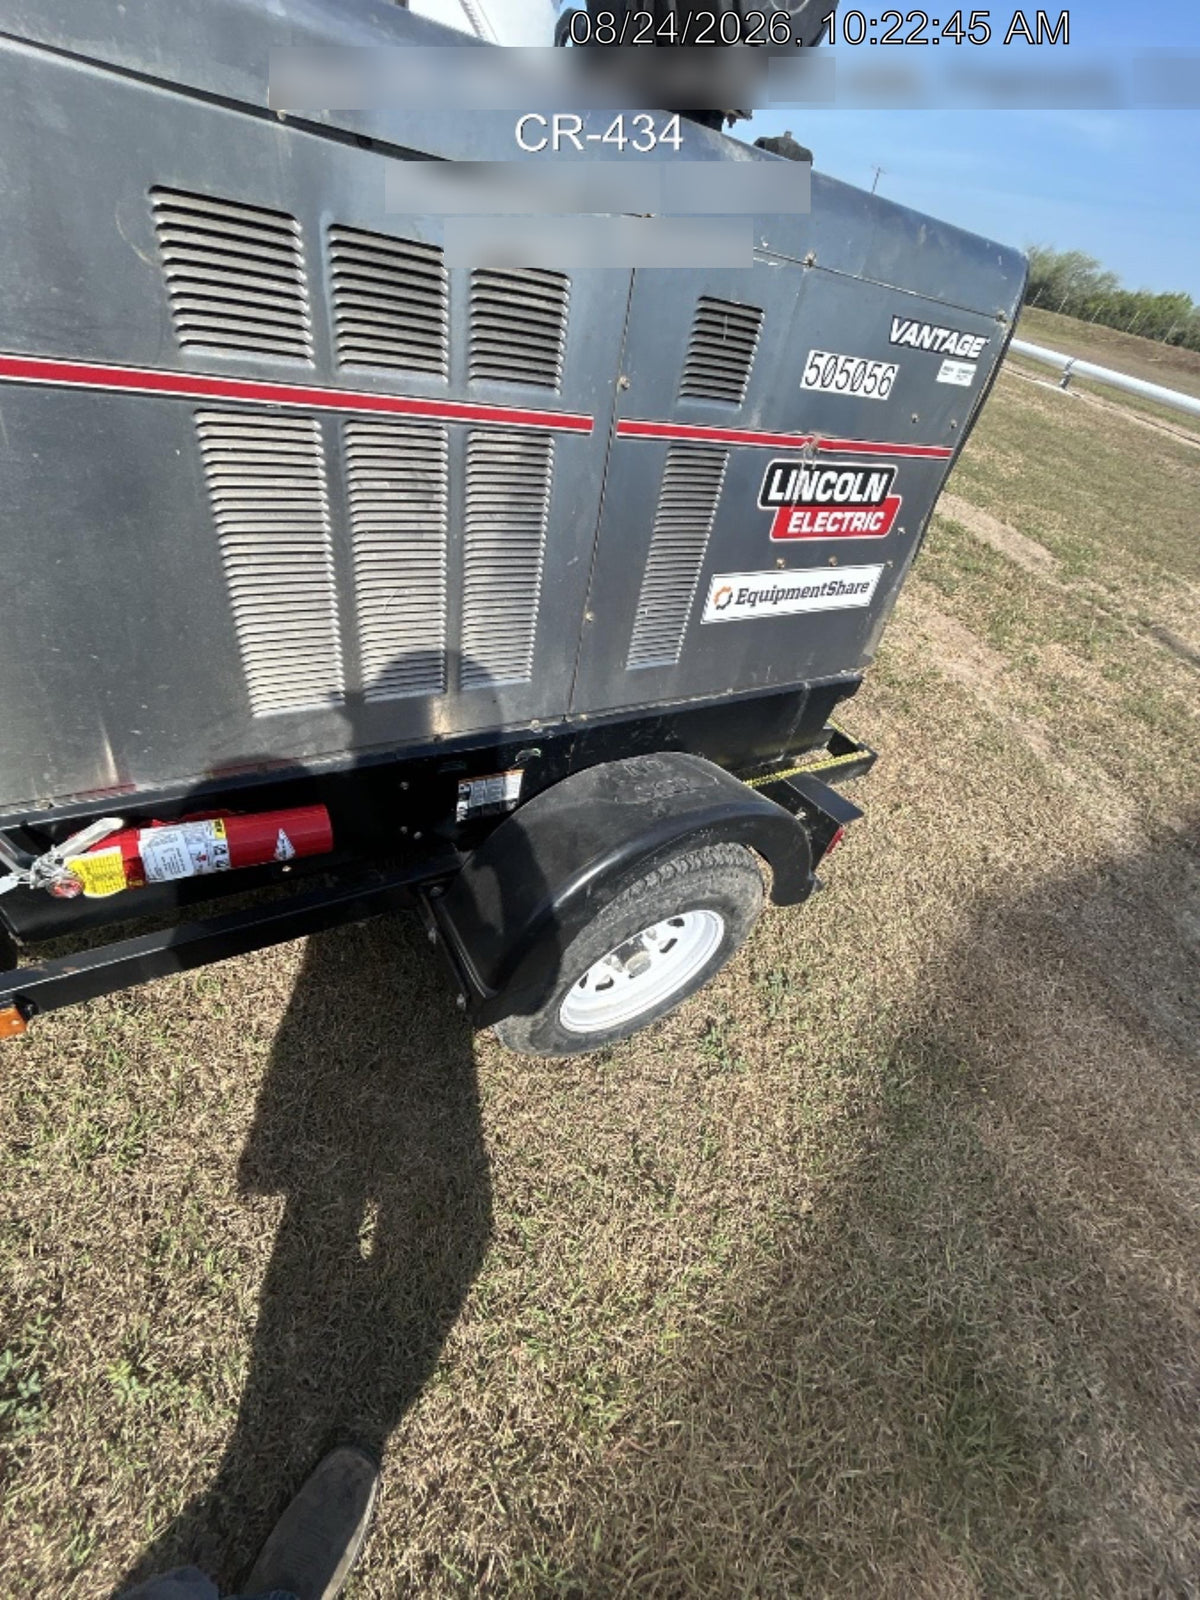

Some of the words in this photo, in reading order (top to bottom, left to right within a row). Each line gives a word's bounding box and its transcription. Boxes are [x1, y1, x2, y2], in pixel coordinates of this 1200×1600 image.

[889, 316, 986, 359] VANTAGE
[804, 352, 895, 397] 505056
[767, 468, 889, 503] LINCOLN
[786, 510, 886, 534] ELECTRIC
[734, 579, 871, 607] EquipmentShare
